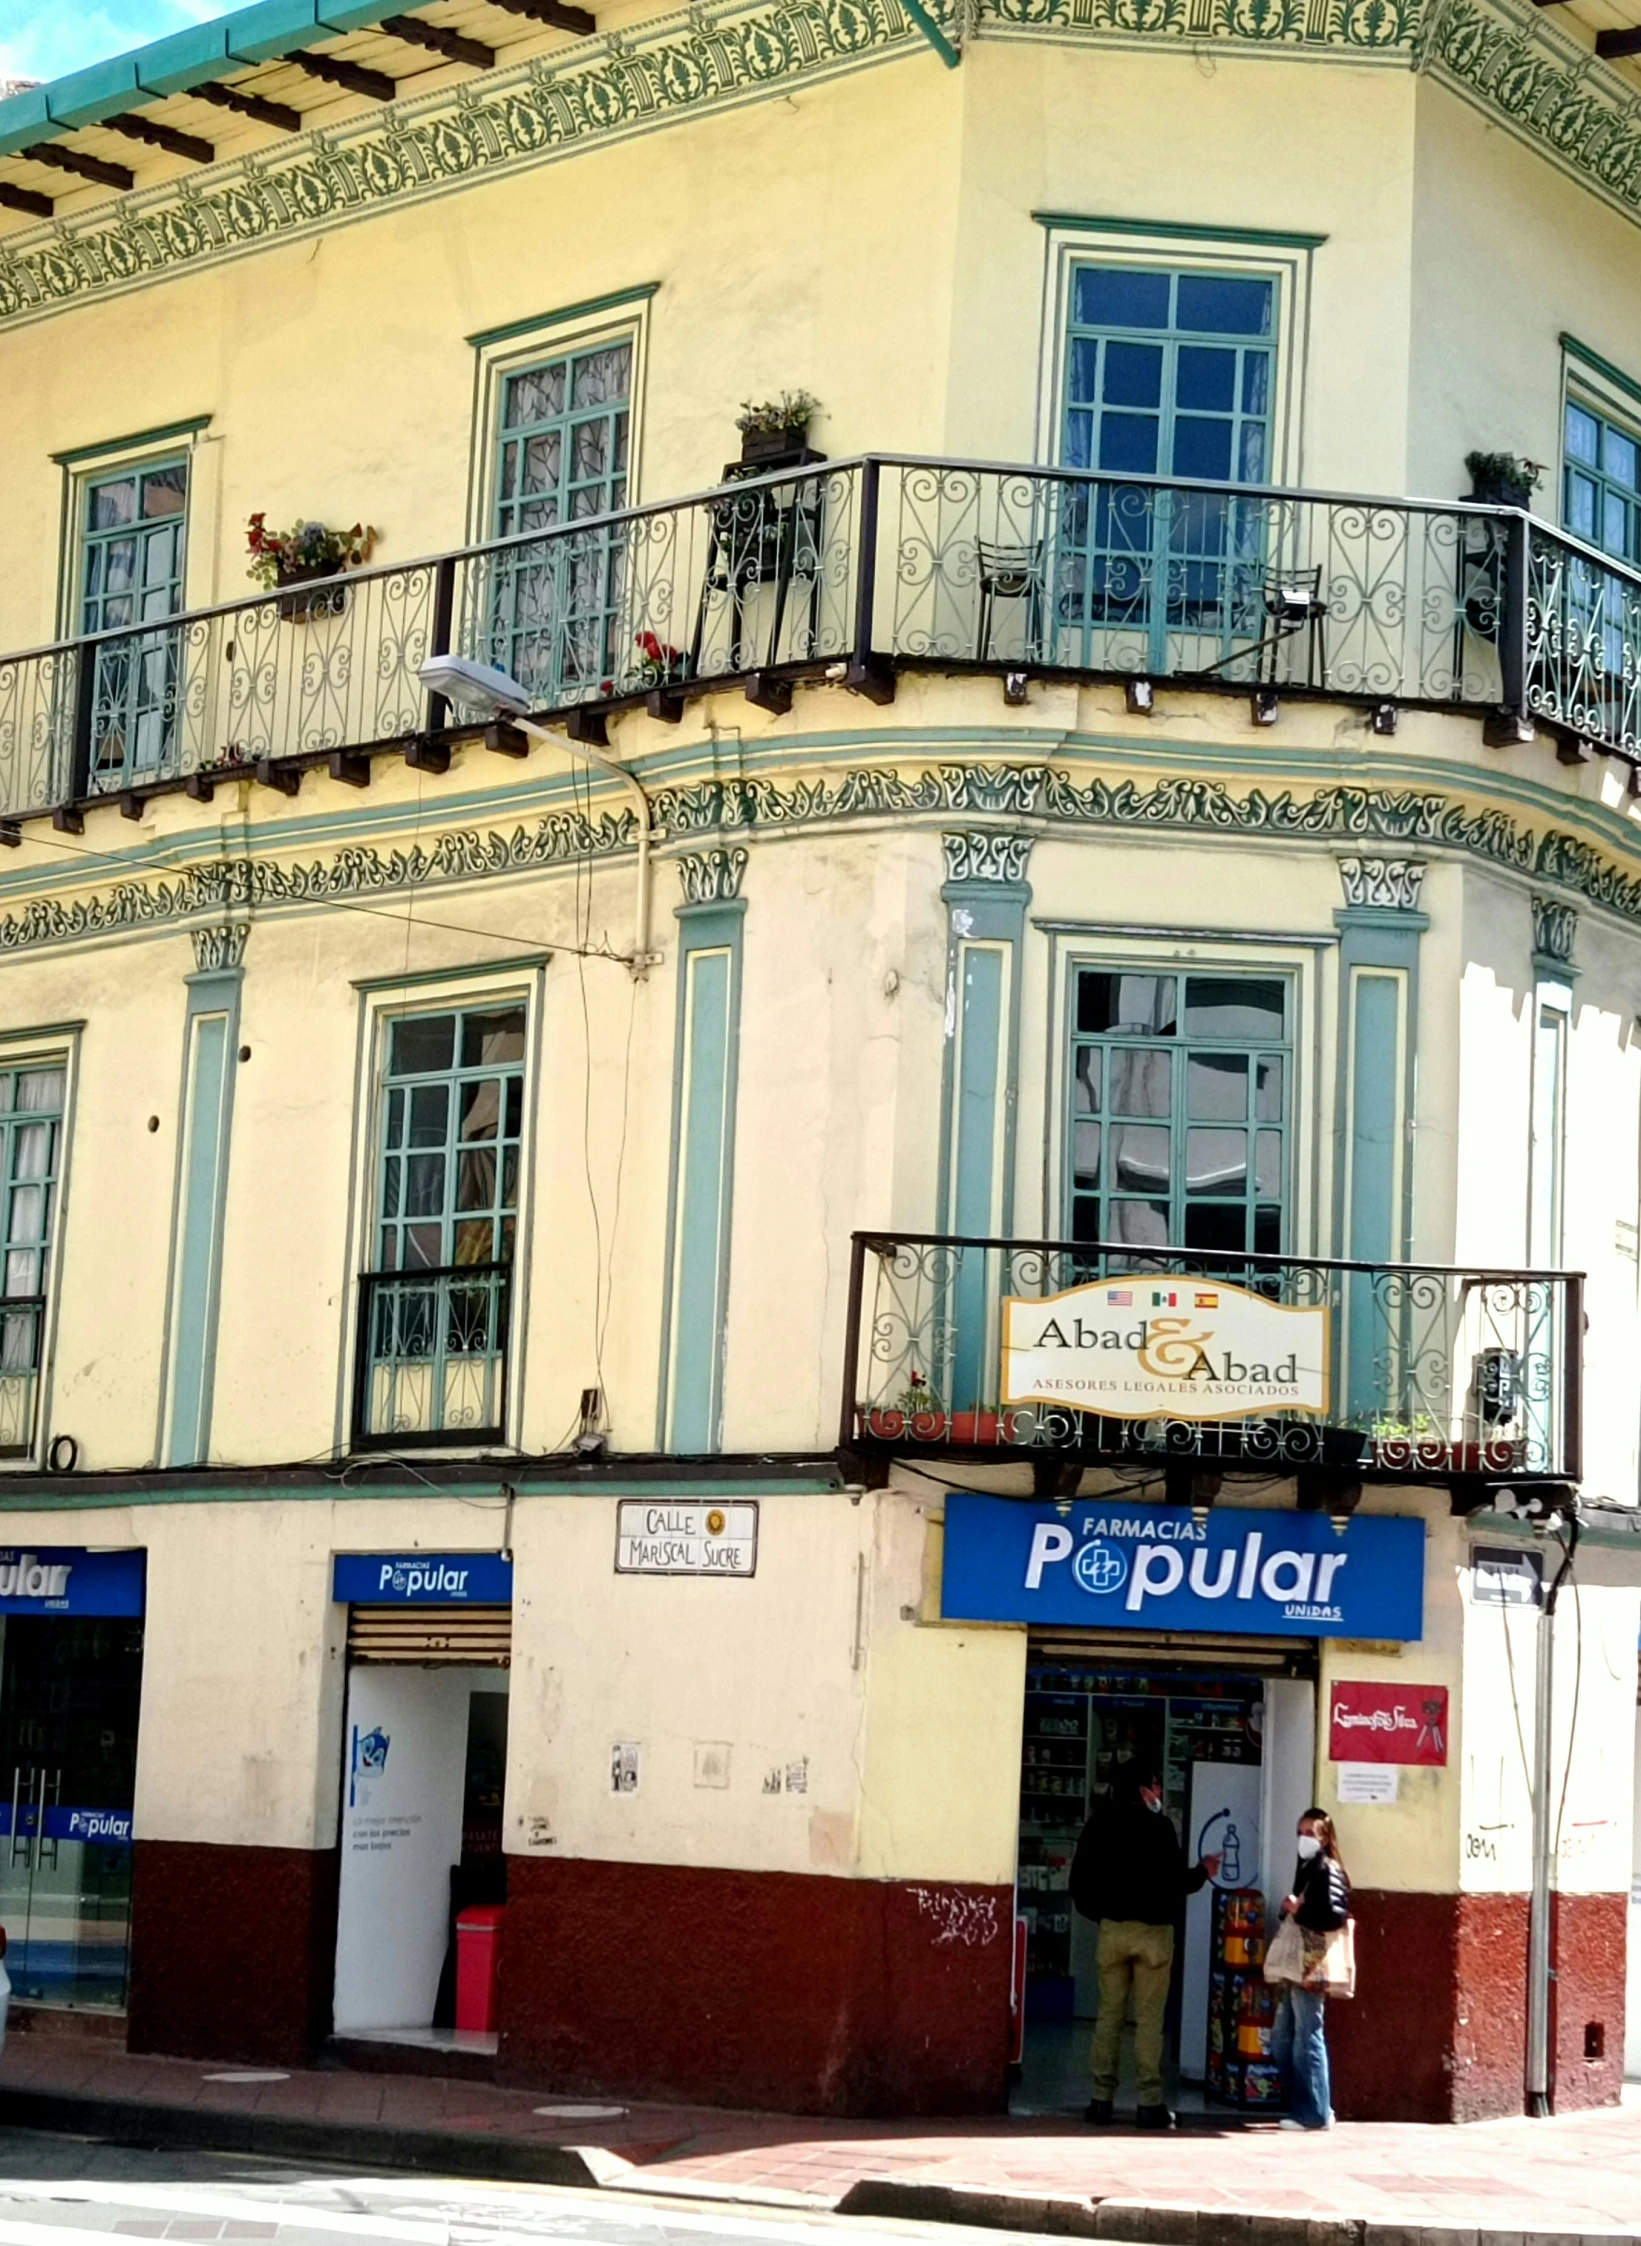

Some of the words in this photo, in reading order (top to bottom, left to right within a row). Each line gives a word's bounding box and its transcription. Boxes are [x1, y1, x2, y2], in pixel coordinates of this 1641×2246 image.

[1033, 1317, 1149, 1350] Abad
[1137, 1317, 1215, 1378] &
[1183, 1350, 1298, 1383] Abad
[1032, 1378, 1117, 1392] ASESORES
[1124, 1381, 1197, 1394] LEGALES
[1203, 1384, 1299, 1397] ASOCIADOS
[646, 1508, 696, 1535] CALLE
[1082, 1517, 1207, 1541] FARMACIAS
[629, 1539, 695, 1567] MARISCAL
[702, 1541, 741, 1569] SUCRE
[1284, 1604, 1343, 1619] UNIDAS
